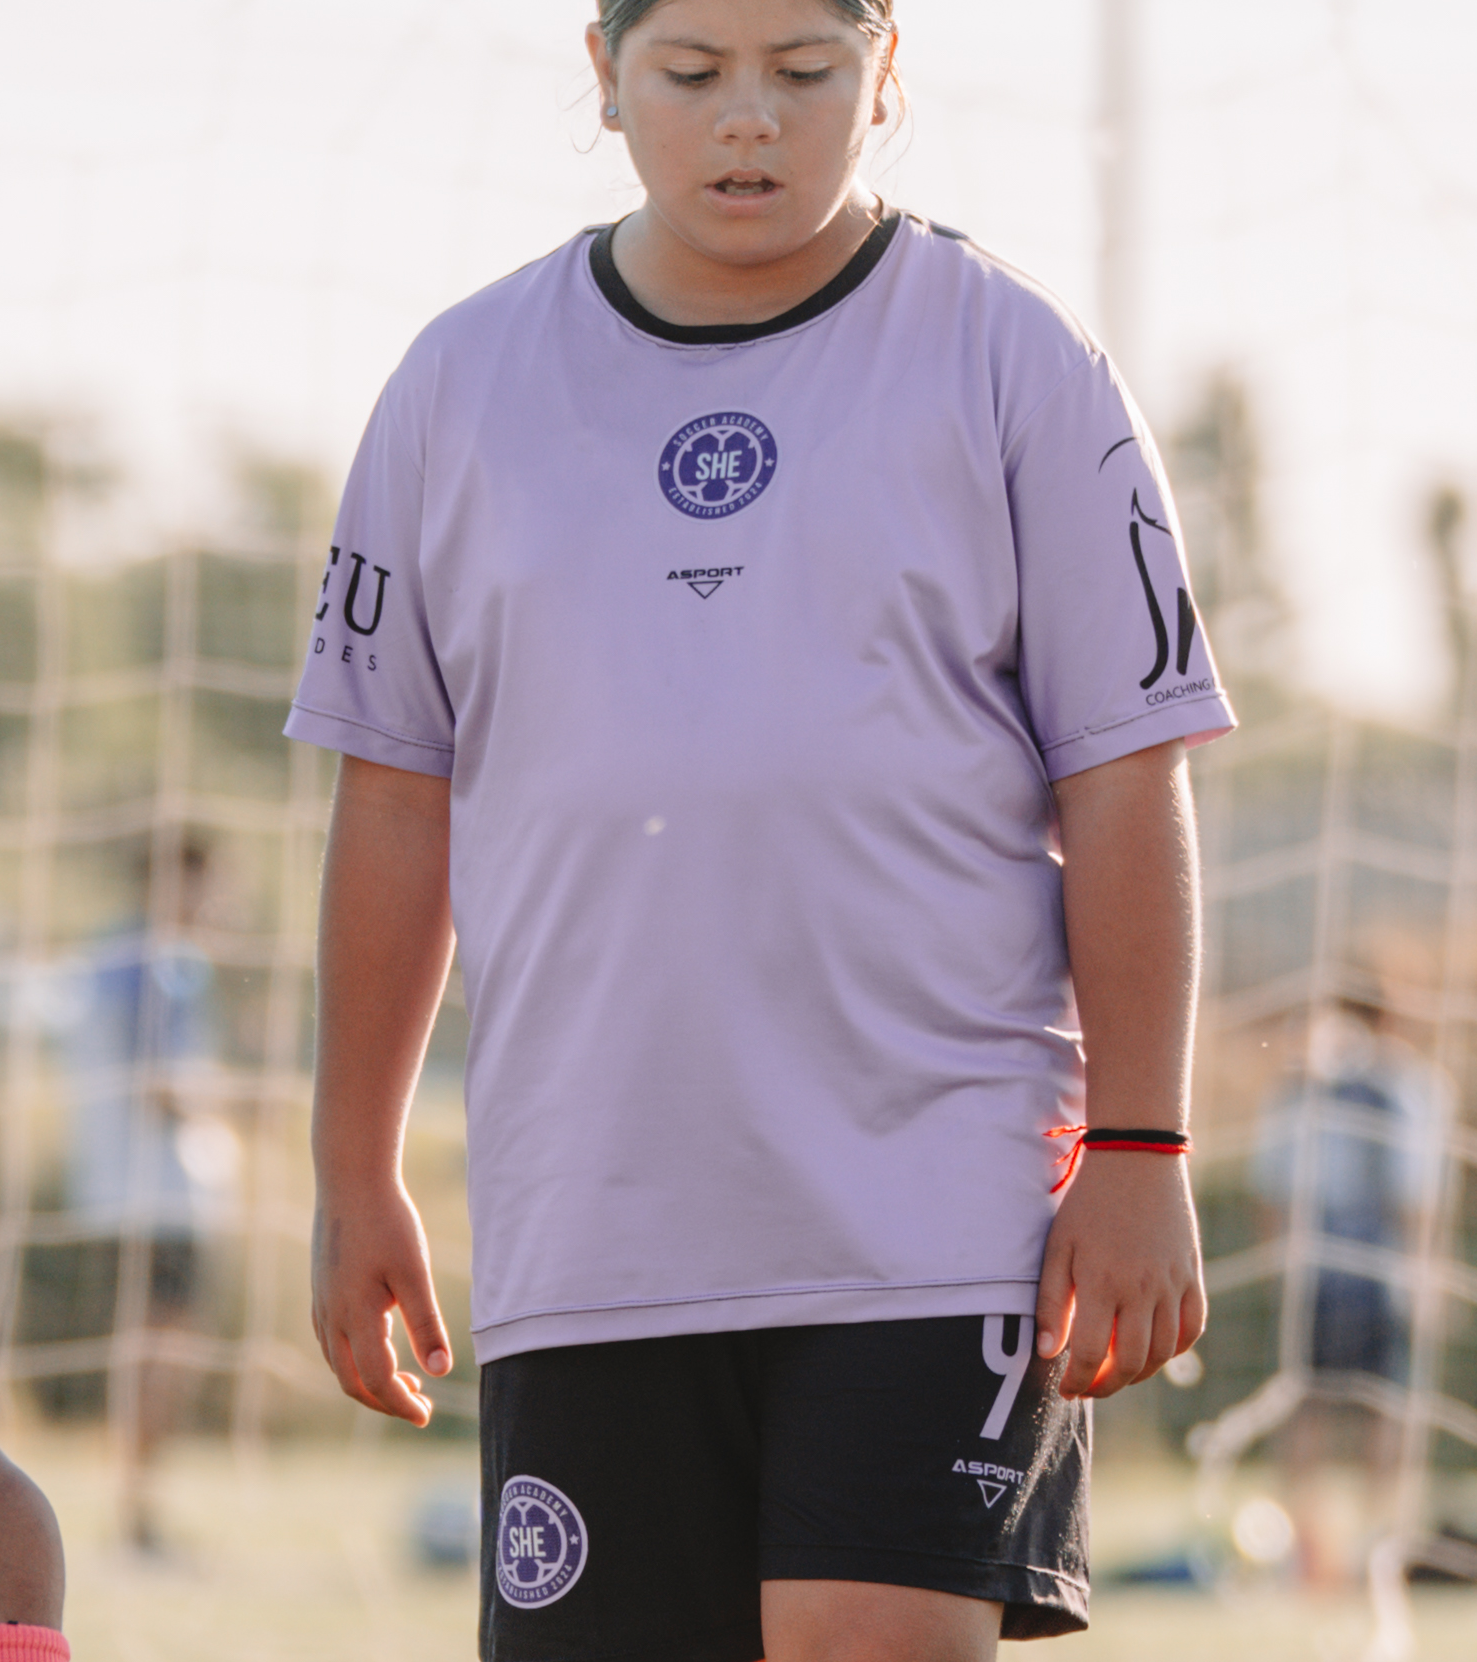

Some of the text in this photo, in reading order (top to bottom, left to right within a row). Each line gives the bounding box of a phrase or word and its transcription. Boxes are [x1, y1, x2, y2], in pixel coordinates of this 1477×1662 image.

[722, 416, 769, 441] ACADEMY
[695, 450, 742, 480] SHE
[668, 487, 735, 516] ESTABLISHED
[666, 566, 745, 580] ASPORT
[1146, 679, 1211, 706] COACHING
[979, 1314, 1035, 1440] 9
[952, 1459, 1024, 1485] ASPORT
[520, 1485, 568, 1518] ACADEMY
[509, 1527, 546, 1557] SHE
